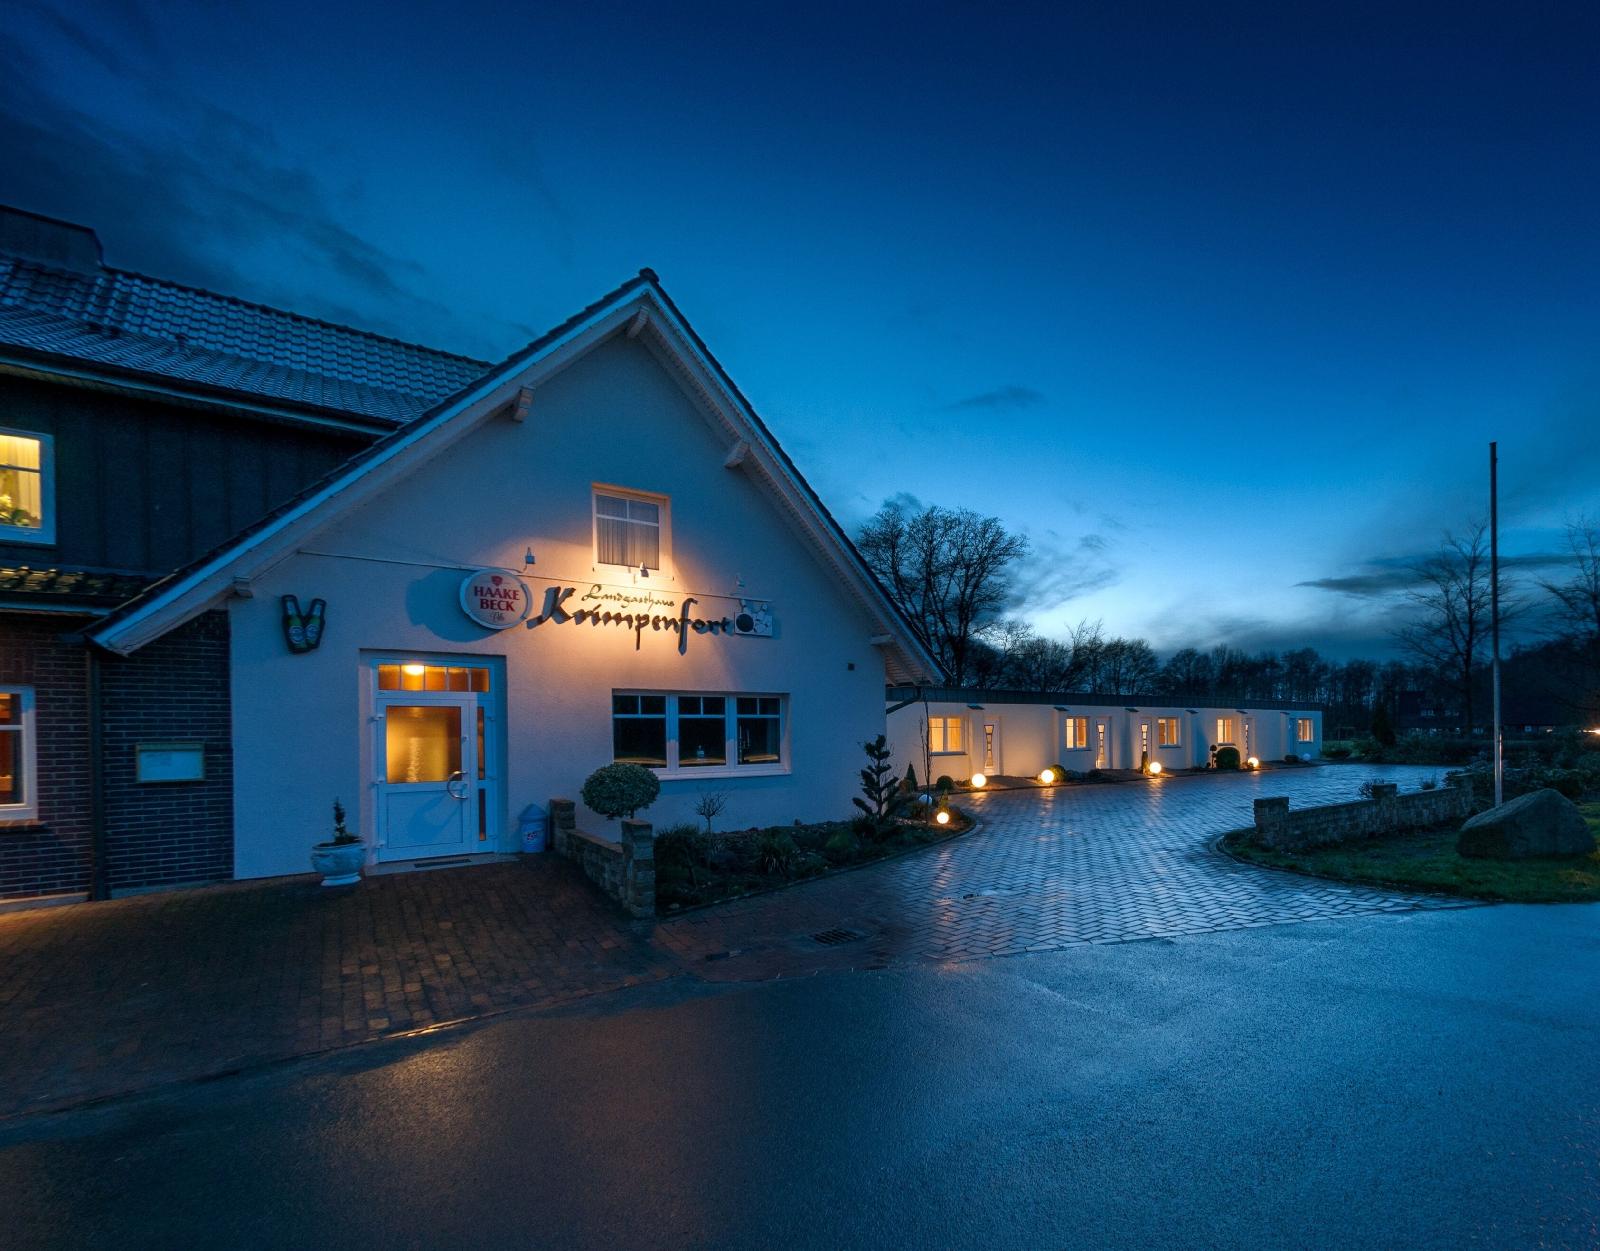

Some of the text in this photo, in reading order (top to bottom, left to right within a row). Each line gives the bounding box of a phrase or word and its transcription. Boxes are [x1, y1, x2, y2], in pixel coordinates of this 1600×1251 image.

[474, 586, 520, 600] HAAKE
[581, 584, 675, 612] Landgasthaus
[480, 599, 515, 612] BECK
[526, 586, 731, 656] Krimpenfort
